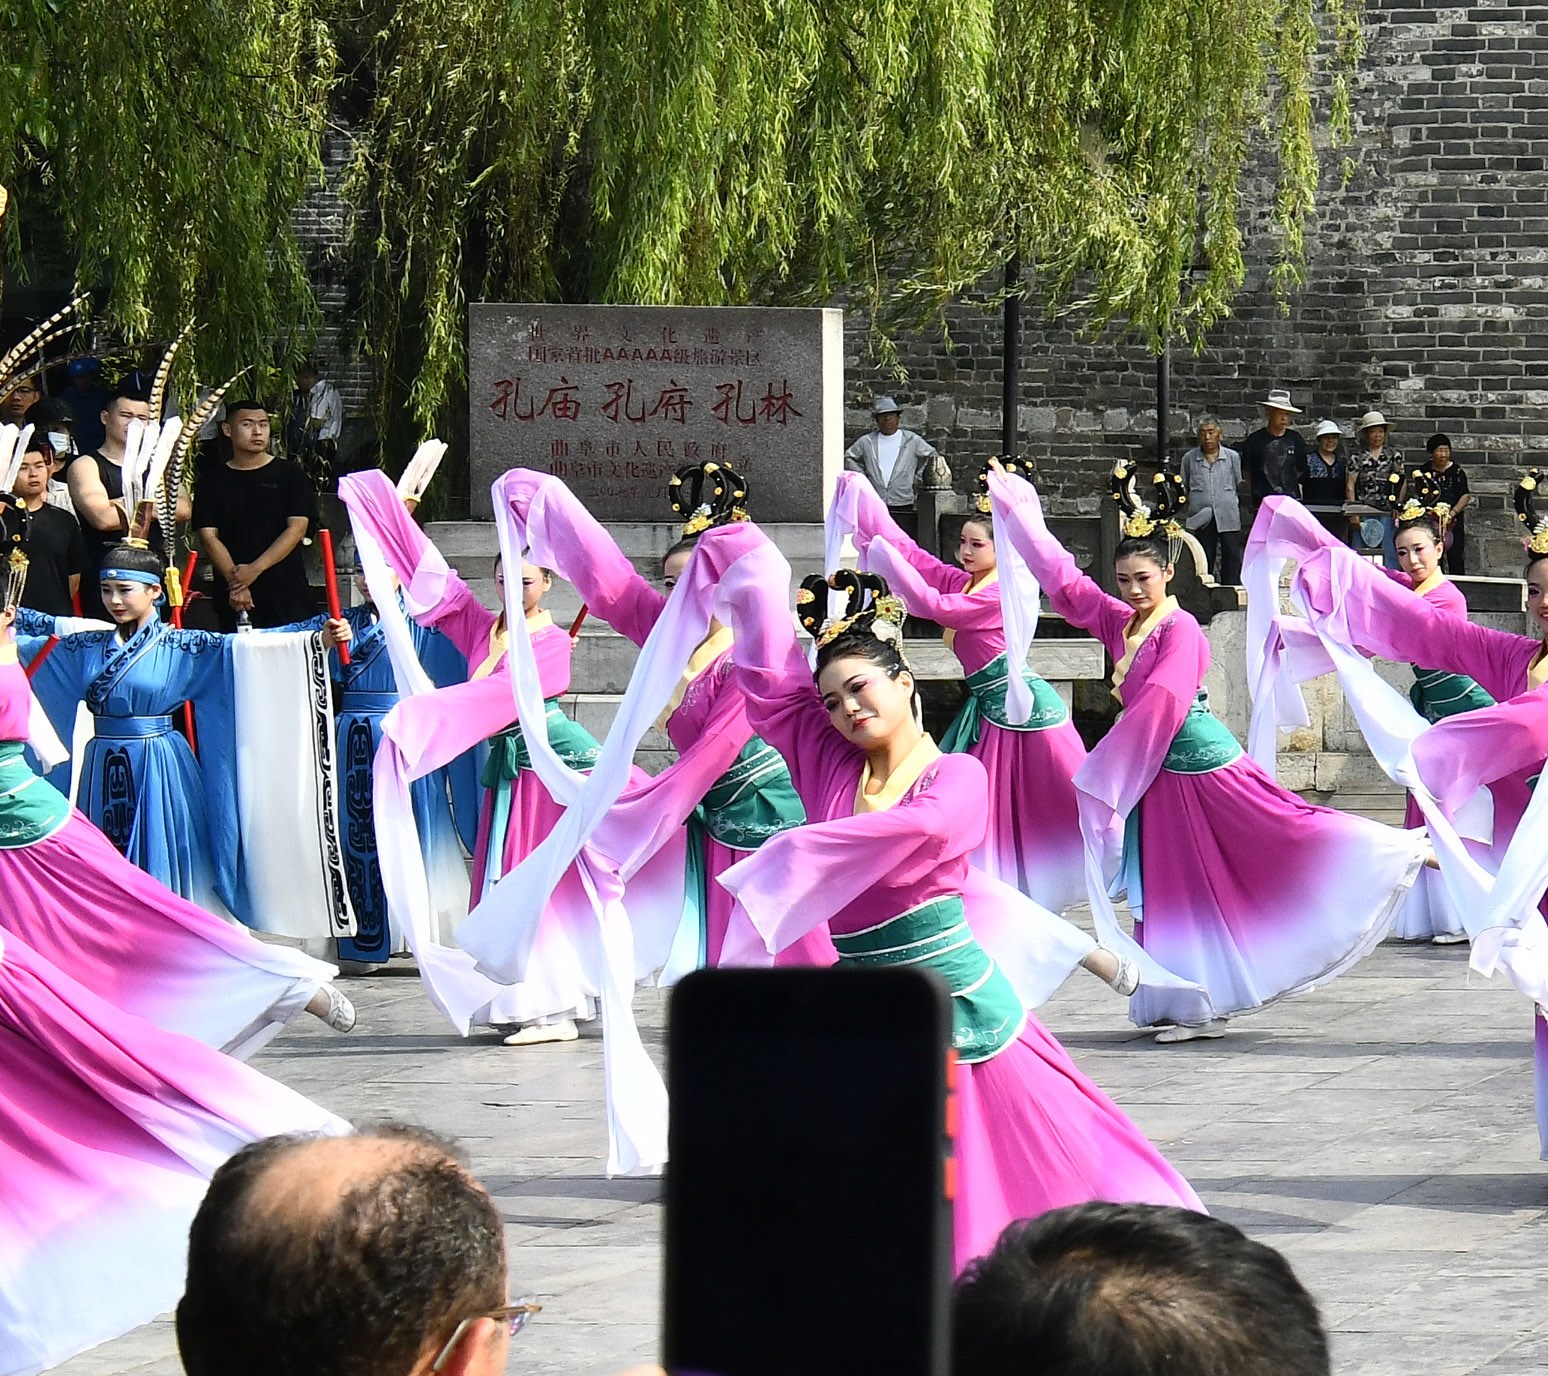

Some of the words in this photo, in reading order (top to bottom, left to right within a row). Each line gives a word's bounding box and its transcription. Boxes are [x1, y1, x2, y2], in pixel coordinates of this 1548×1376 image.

[489, 376, 581, 422] 孔庙
[601, 378, 693, 424] 孔府
[711, 379, 803, 425] 孔林
